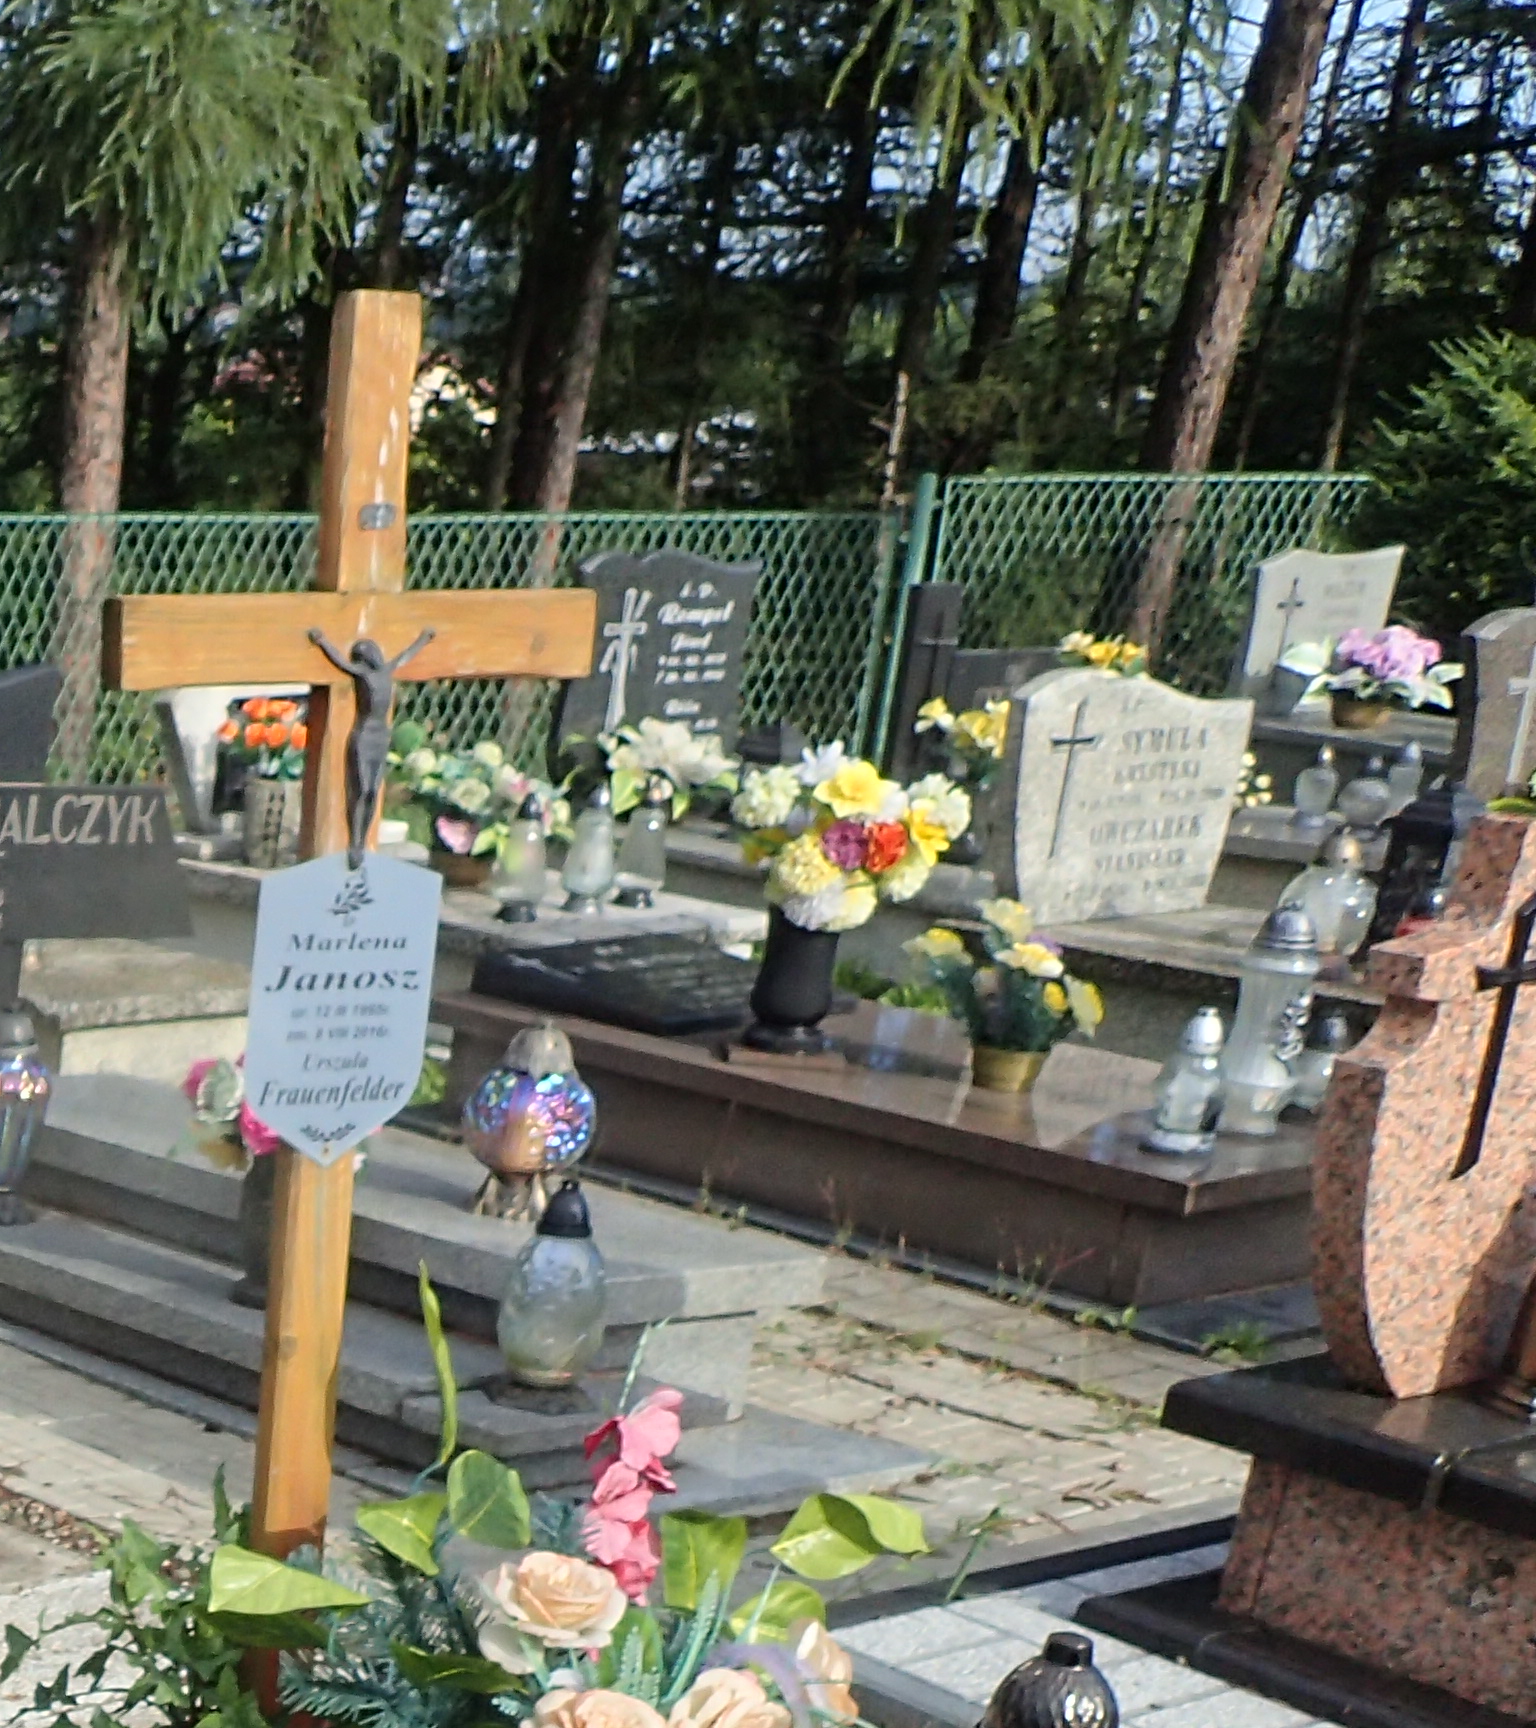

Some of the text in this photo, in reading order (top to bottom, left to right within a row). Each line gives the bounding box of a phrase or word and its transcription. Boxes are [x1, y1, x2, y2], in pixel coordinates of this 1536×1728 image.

[287, 933, 407, 951] Marlena
[265, 965, 419, 992] Janosz
[258, 1076, 406, 1110] Frauenfelder
